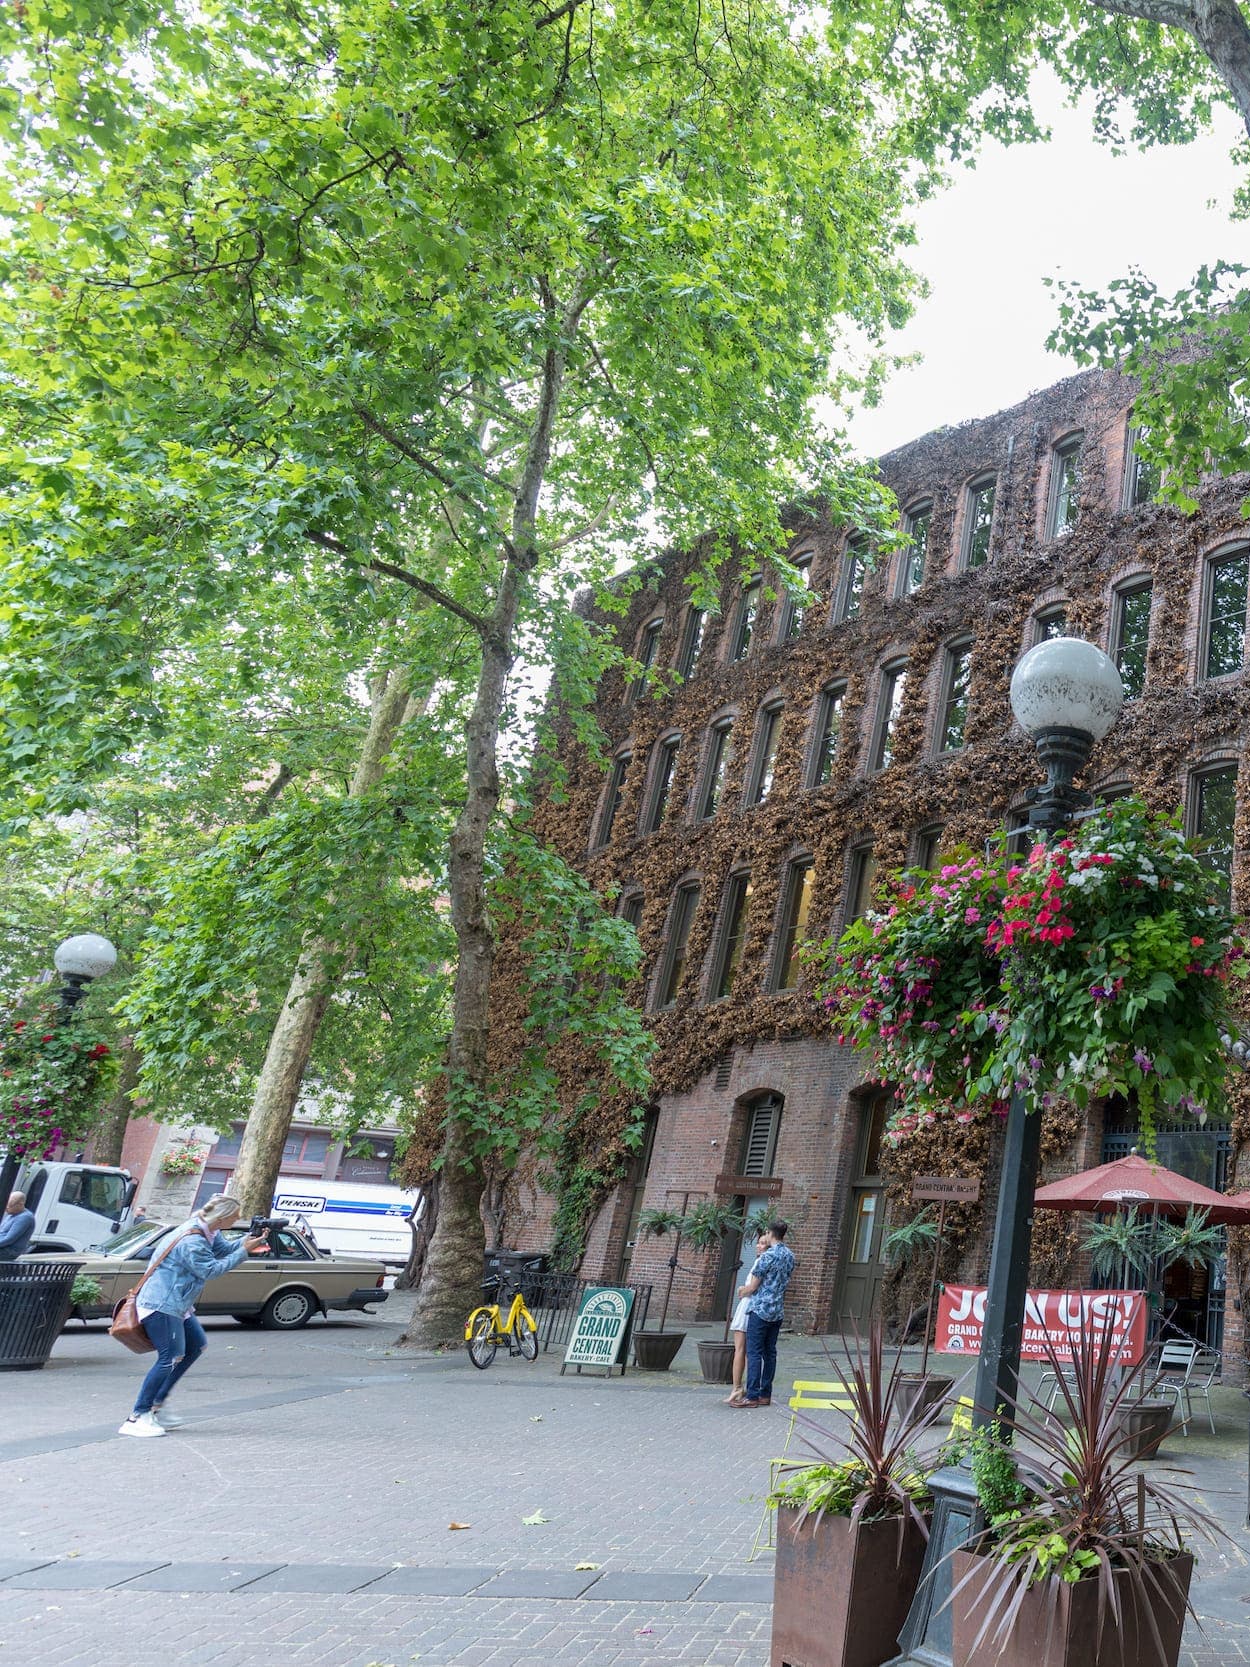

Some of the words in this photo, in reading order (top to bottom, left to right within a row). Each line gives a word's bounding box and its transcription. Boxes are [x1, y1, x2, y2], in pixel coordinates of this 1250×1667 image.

[280, 1199, 320, 1208] PENSKE
[949, 1290, 1048, 1326] JON
[1058, 1294, 1133, 1330] US!
[578, 1316, 621, 1337] GRAND
[947, 1323, 978, 1336] GRAND
[573, 1338, 613, 1355] CENTRAL
